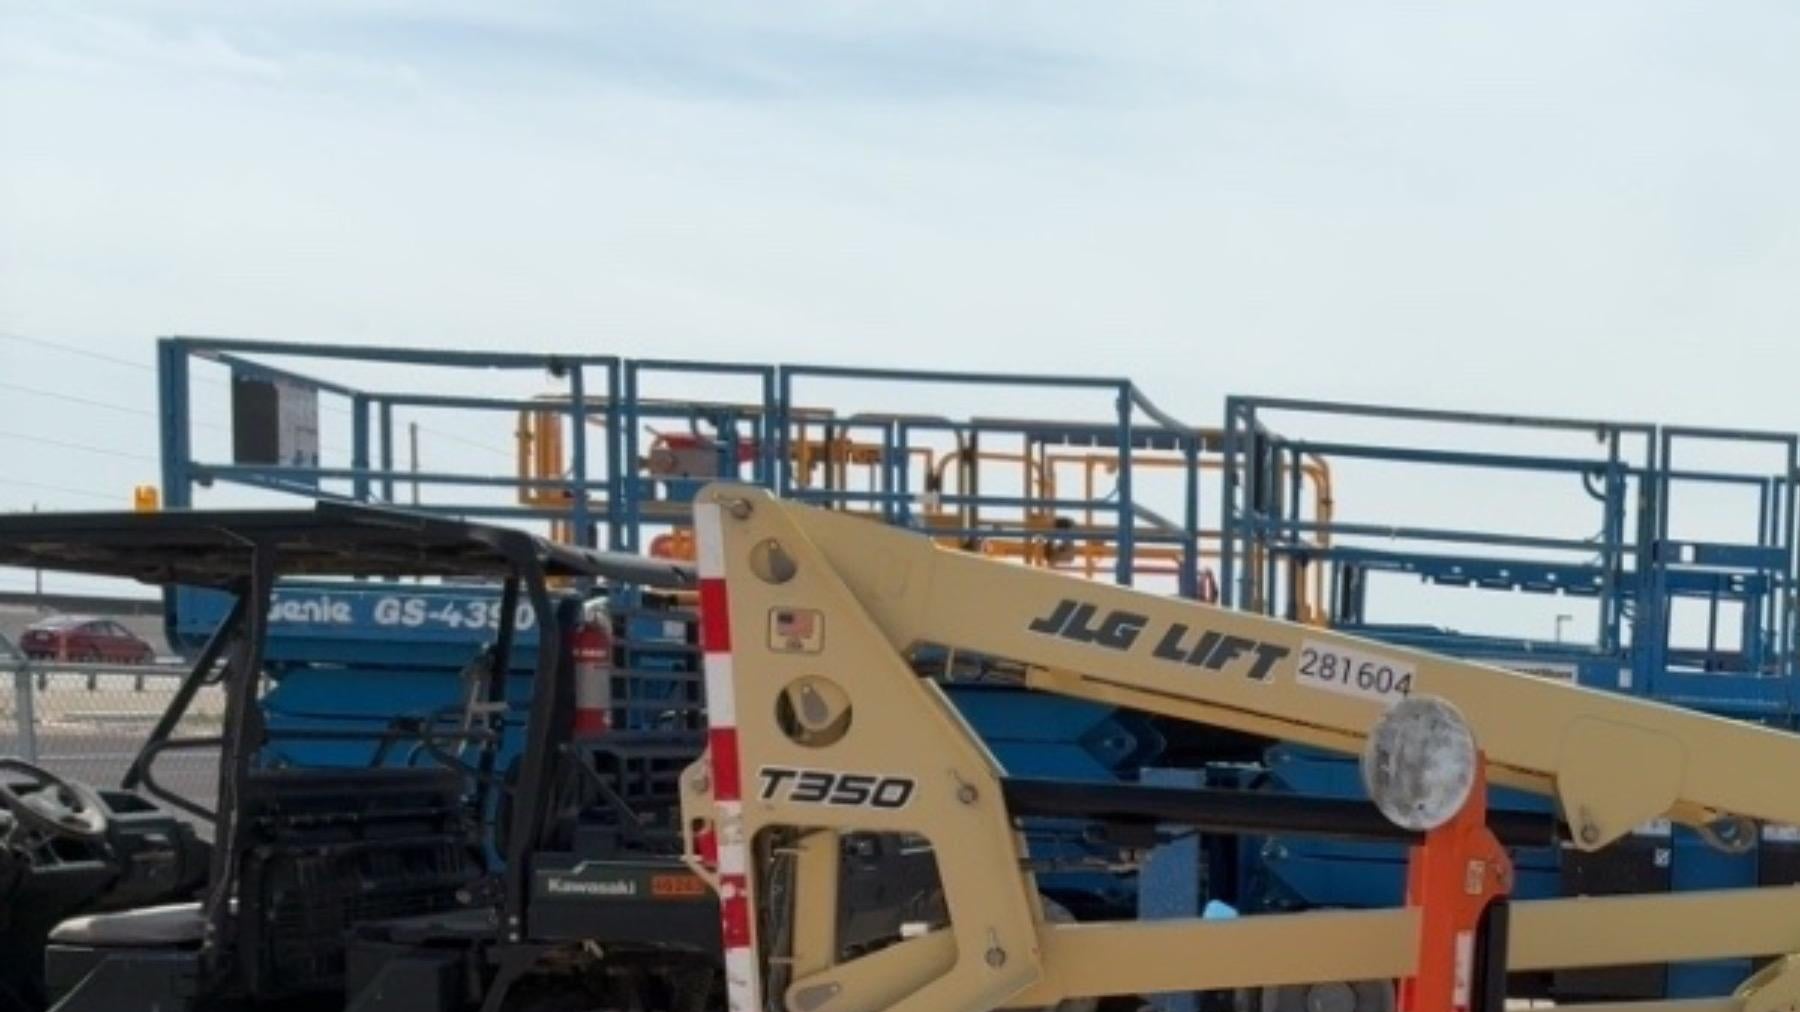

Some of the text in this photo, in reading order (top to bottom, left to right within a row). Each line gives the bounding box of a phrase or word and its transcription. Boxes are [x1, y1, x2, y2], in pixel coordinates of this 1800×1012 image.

[1028, 599, 1292, 681] JLG LIFT
[1298, 646, 1414, 698] 281604
[759, 766, 916, 809] T350
[548, 877, 637, 896] Kawasaki
